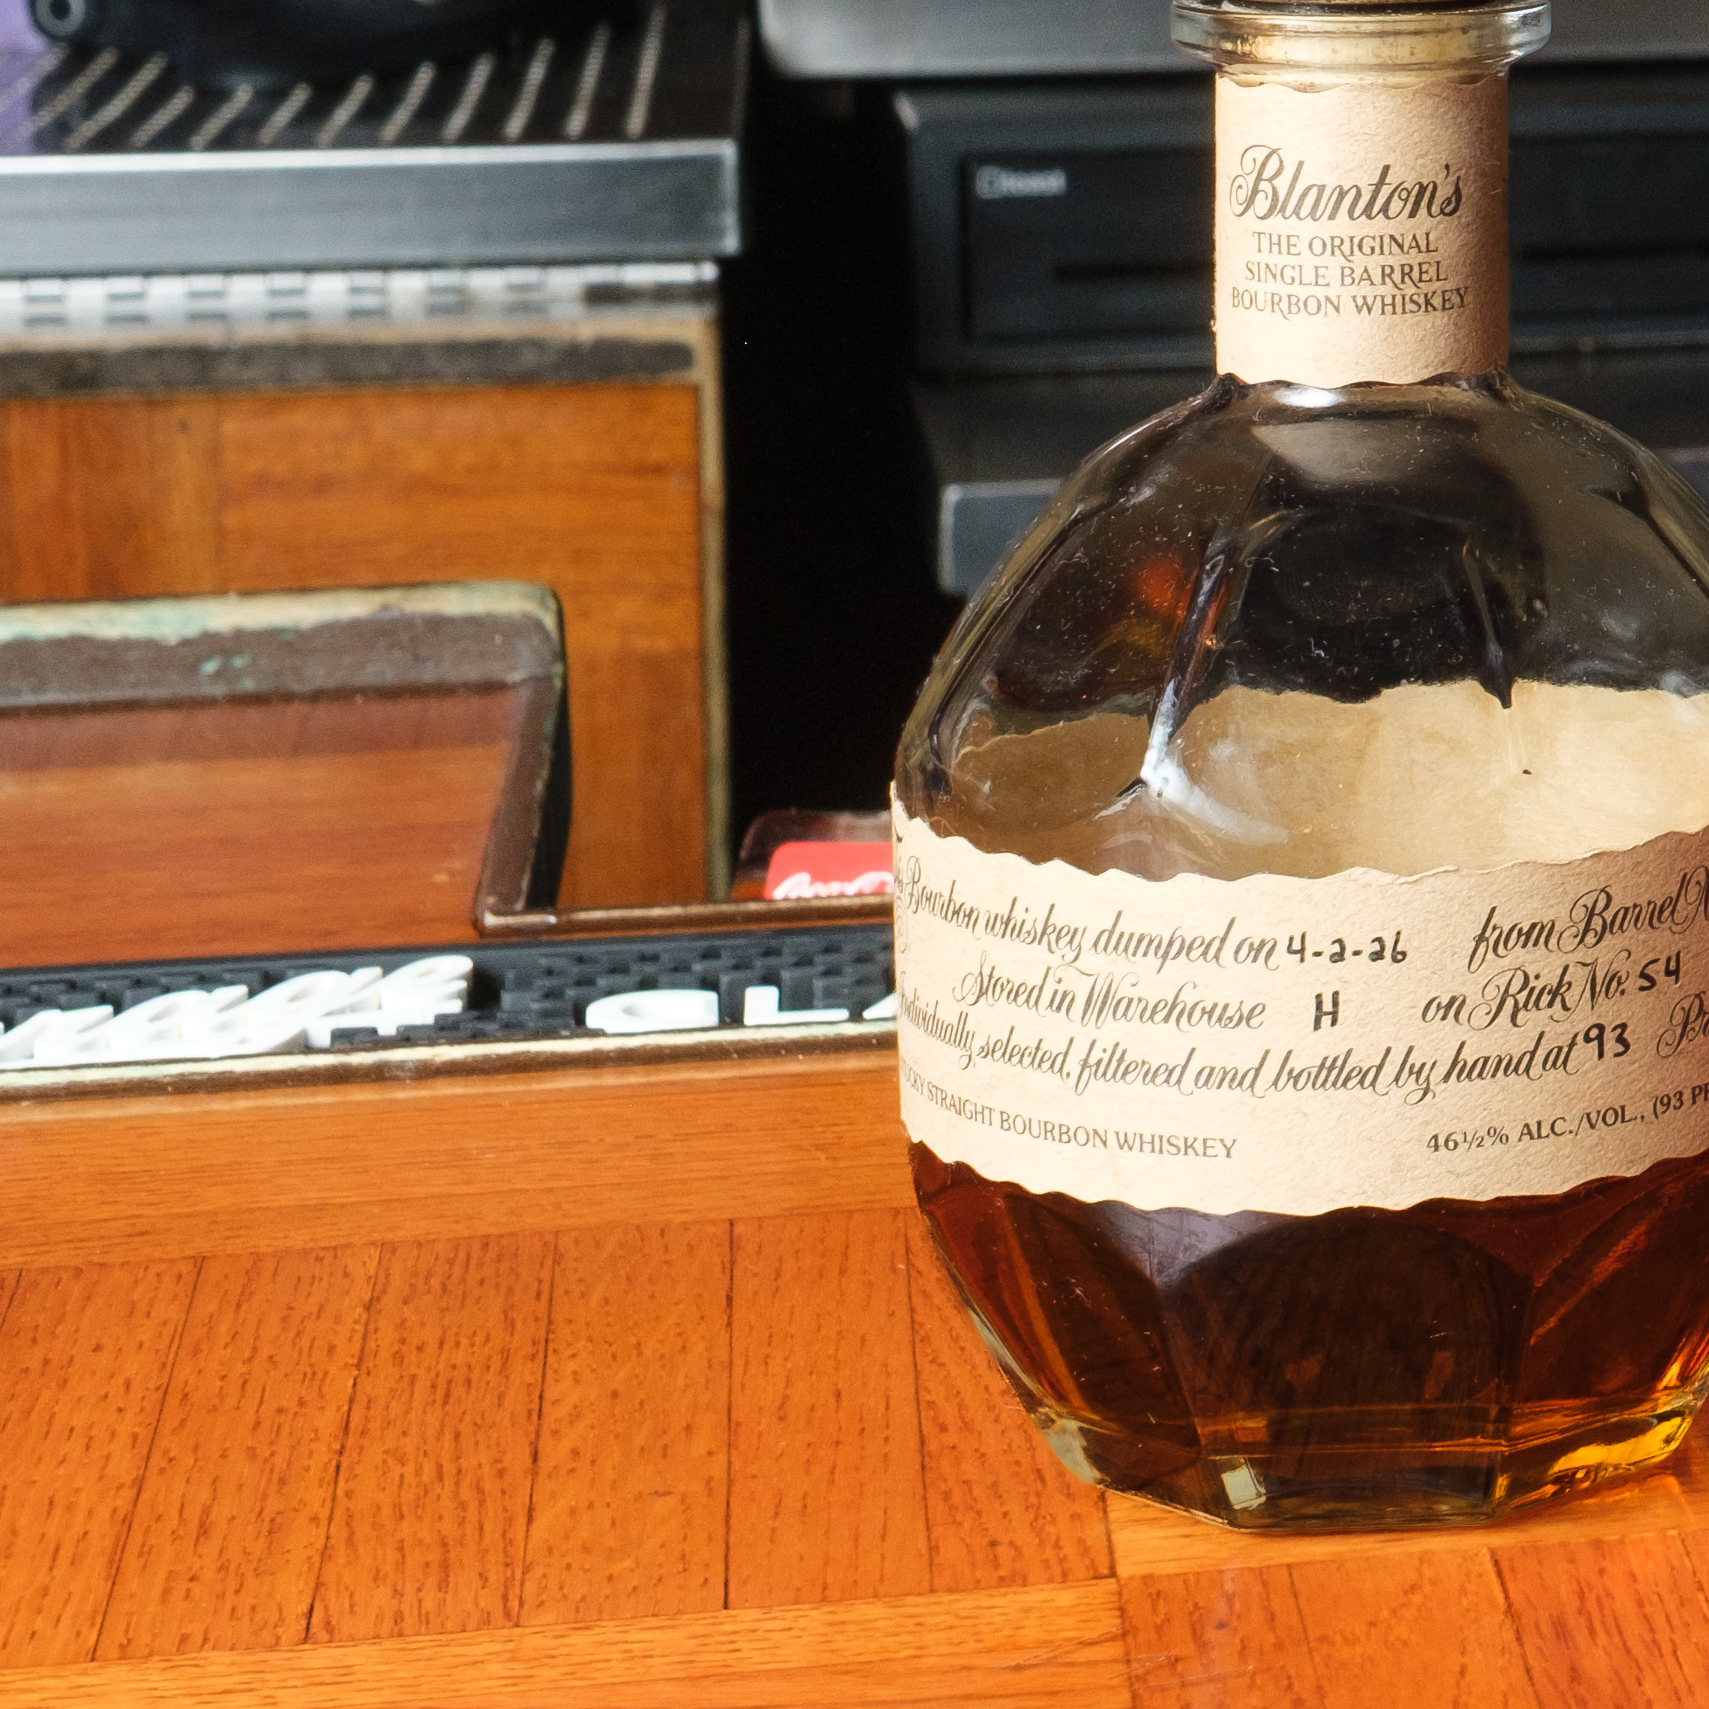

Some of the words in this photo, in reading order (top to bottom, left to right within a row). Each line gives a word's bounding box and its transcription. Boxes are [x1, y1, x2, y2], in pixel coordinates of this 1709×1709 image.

[1229, 144, 1463, 222] Blanton's
[1252, 231, 1301, 256] THE
[1308, 232, 1439, 263] ORIGINAL
[1245, 260, 1330, 288] SINGLE
[1340, 261, 1449, 291] BARREL
[1232, 286, 1342, 321] BOURBON
[1350, 286, 1470, 317] WHISKEY
[904, 854, 982, 940] Bourbon
[984, 895, 1089, 964] whiskey
[1093, 909, 1228, 974] dumped
[1232, 937, 1280, 970] on
[1467, 905, 1557, 974] from
[1556, 885, 1686, 954] Barrel
[952, 949, 1055, 1016] Stored
[1637, 949, 1682, 992] 54
[1048, 977, 1078, 1023] in
[1053, 961, 1267, 1032] Warehouse
[1312, 990, 1341, 1032] H
[1421, 994, 1467, 1027] on
[1467, 962, 1573, 1031] Rick
[1074, 1037, 1197, 1096] filtered
[1194, 1048, 1270, 1098] and
[1264, 1048, 1393, 1098] bottled
[1393, 1045, 1437, 1106] by
[1441, 1031, 1545, 1086] hand
[1540, 1034, 1581, 1076] at
[1581, 1022, 1632, 1062] 93
[927, 1082, 996, 1129] STRAIGHT
[999, 1110, 1108, 1150] BOURBON
[1112, 1130, 1238, 1160] WHISKEY
[1651, 1084, 1685, 1120] (93
